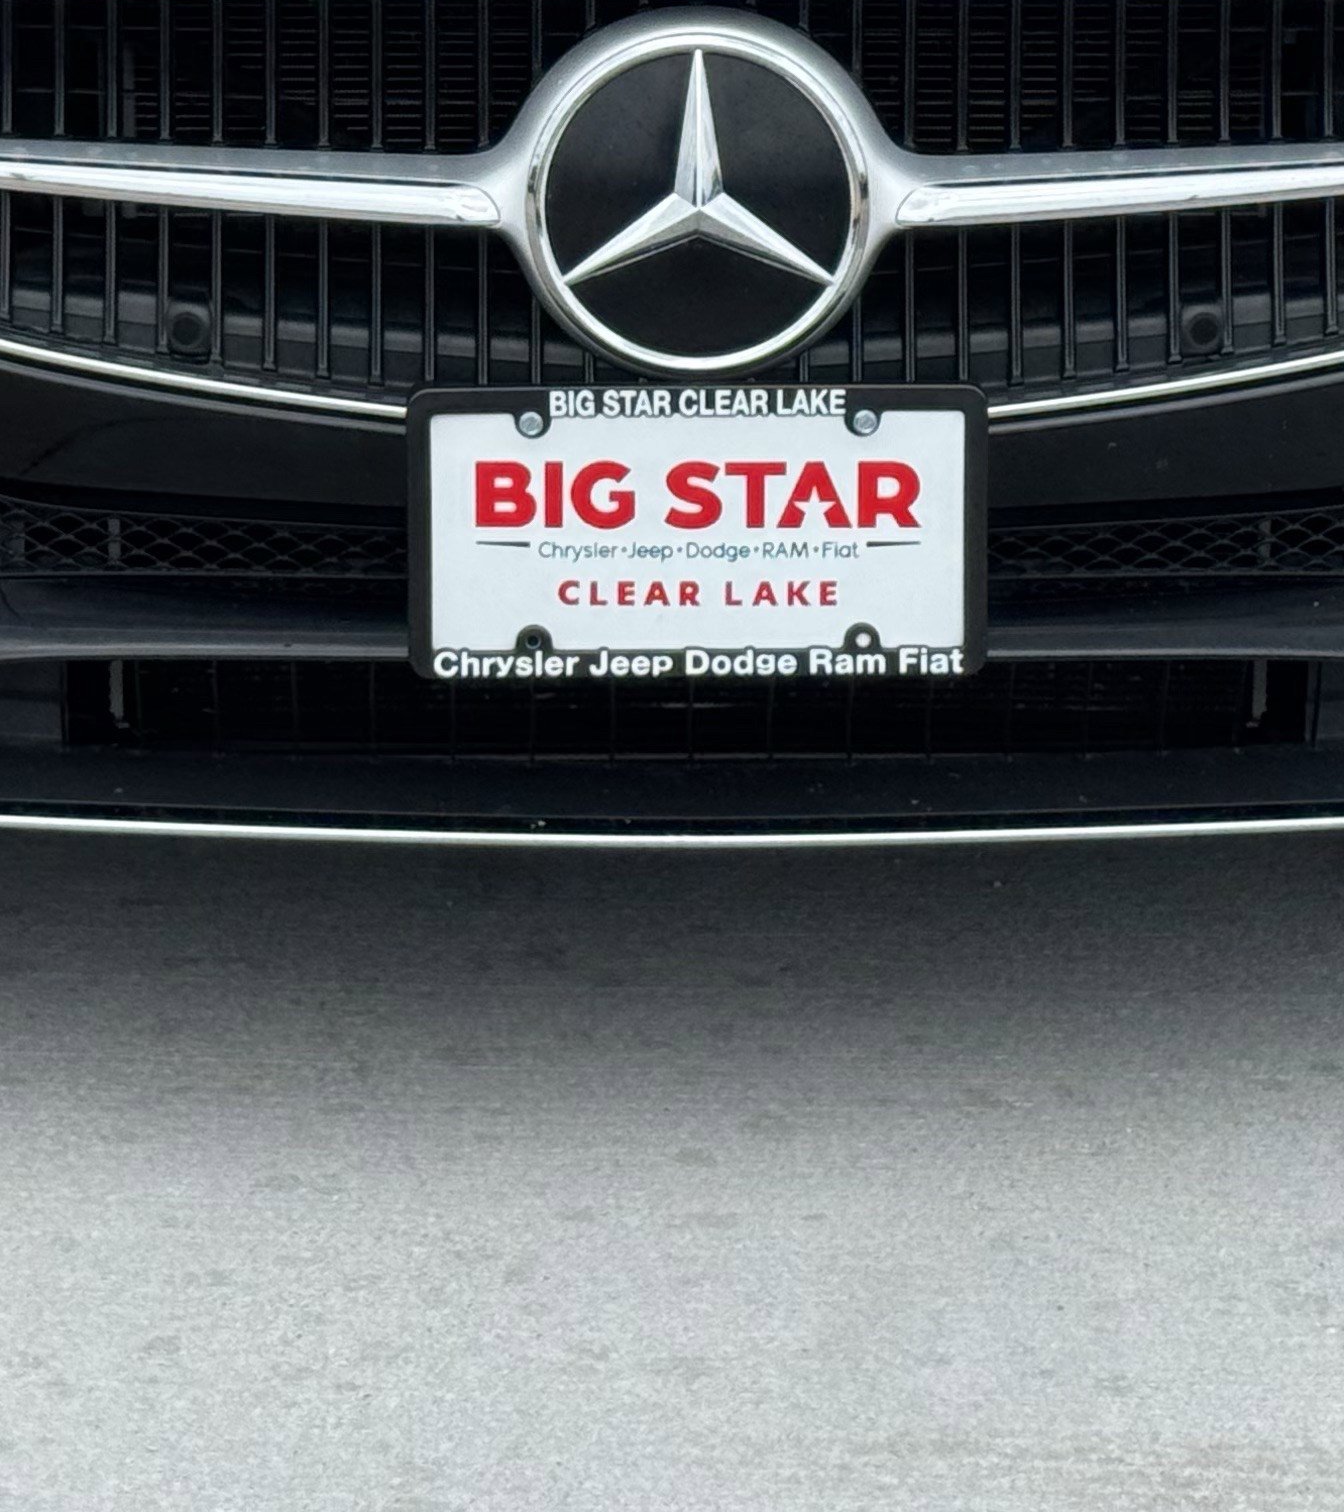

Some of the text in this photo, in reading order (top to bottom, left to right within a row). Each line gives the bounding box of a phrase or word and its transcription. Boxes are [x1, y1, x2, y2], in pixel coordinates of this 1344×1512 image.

[548, 388, 847, 416] BIG STAR CLEAR LAKE
[474, 460, 921, 529] BIG STAR
[537, 541, 860, 563] Chrysler Jeep Dodge RAM Fiat
[558, 580, 839, 606] CLEAR LAKE
[433, 647, 965, 678] Chrysler Jeep Dodge Ram Fiat
